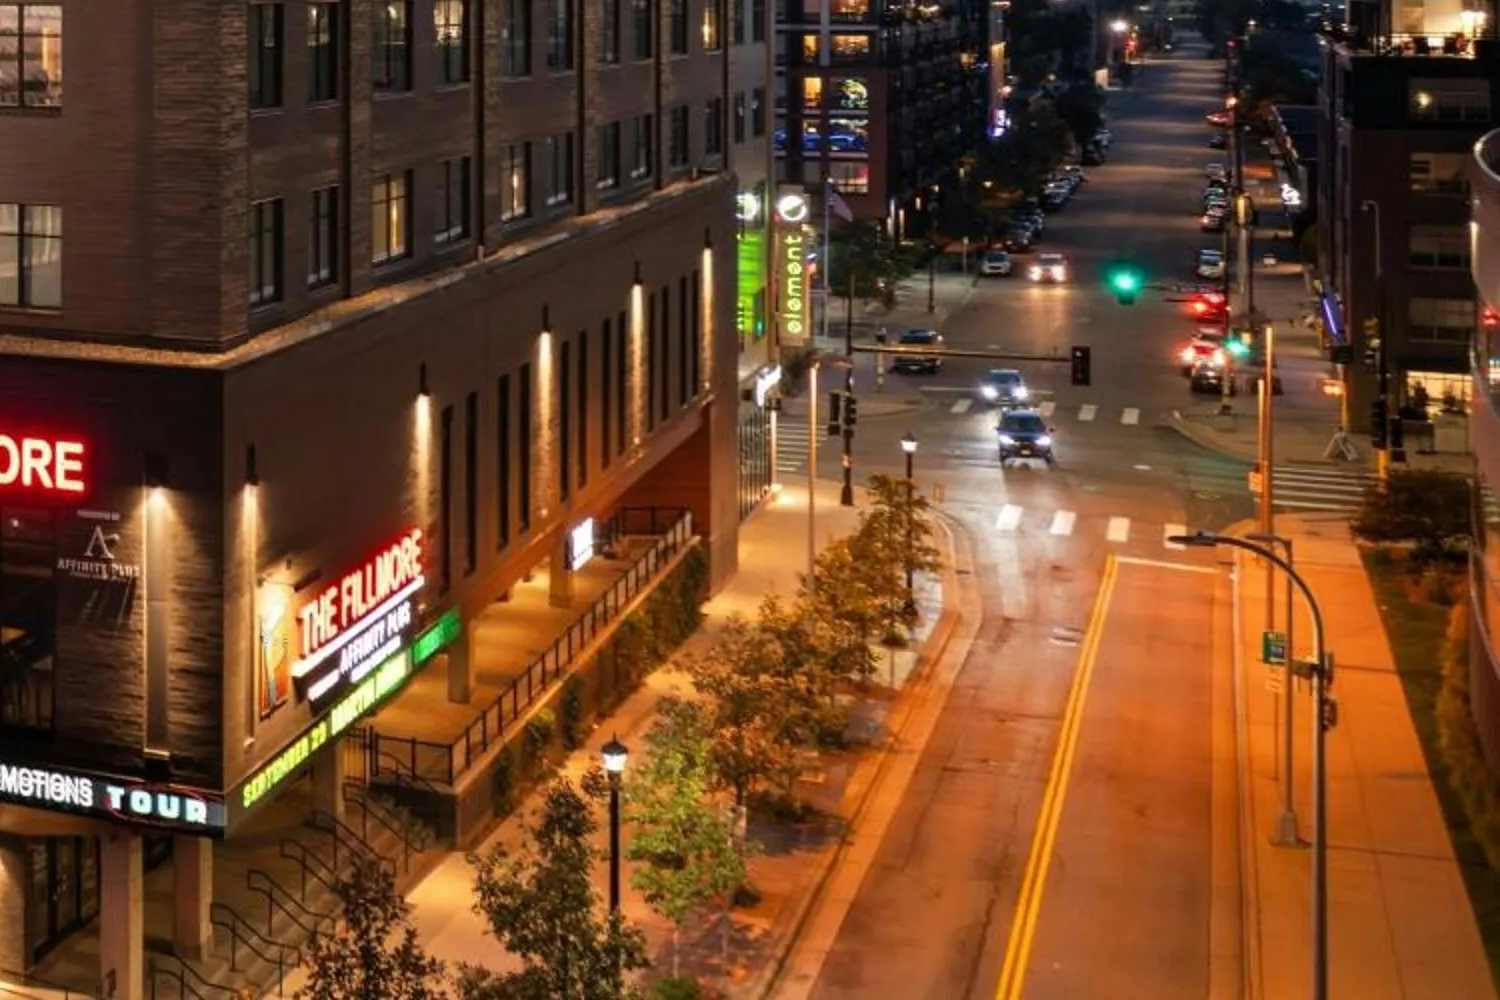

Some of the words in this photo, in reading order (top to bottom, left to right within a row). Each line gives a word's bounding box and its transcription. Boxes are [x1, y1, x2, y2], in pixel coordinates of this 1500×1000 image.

[784, 235, 803, 334] element
[301, 586, 338, 658] THE
[341, 529, 422, 628] FILLMORE
[106, 785, 207, 824] TOUR
